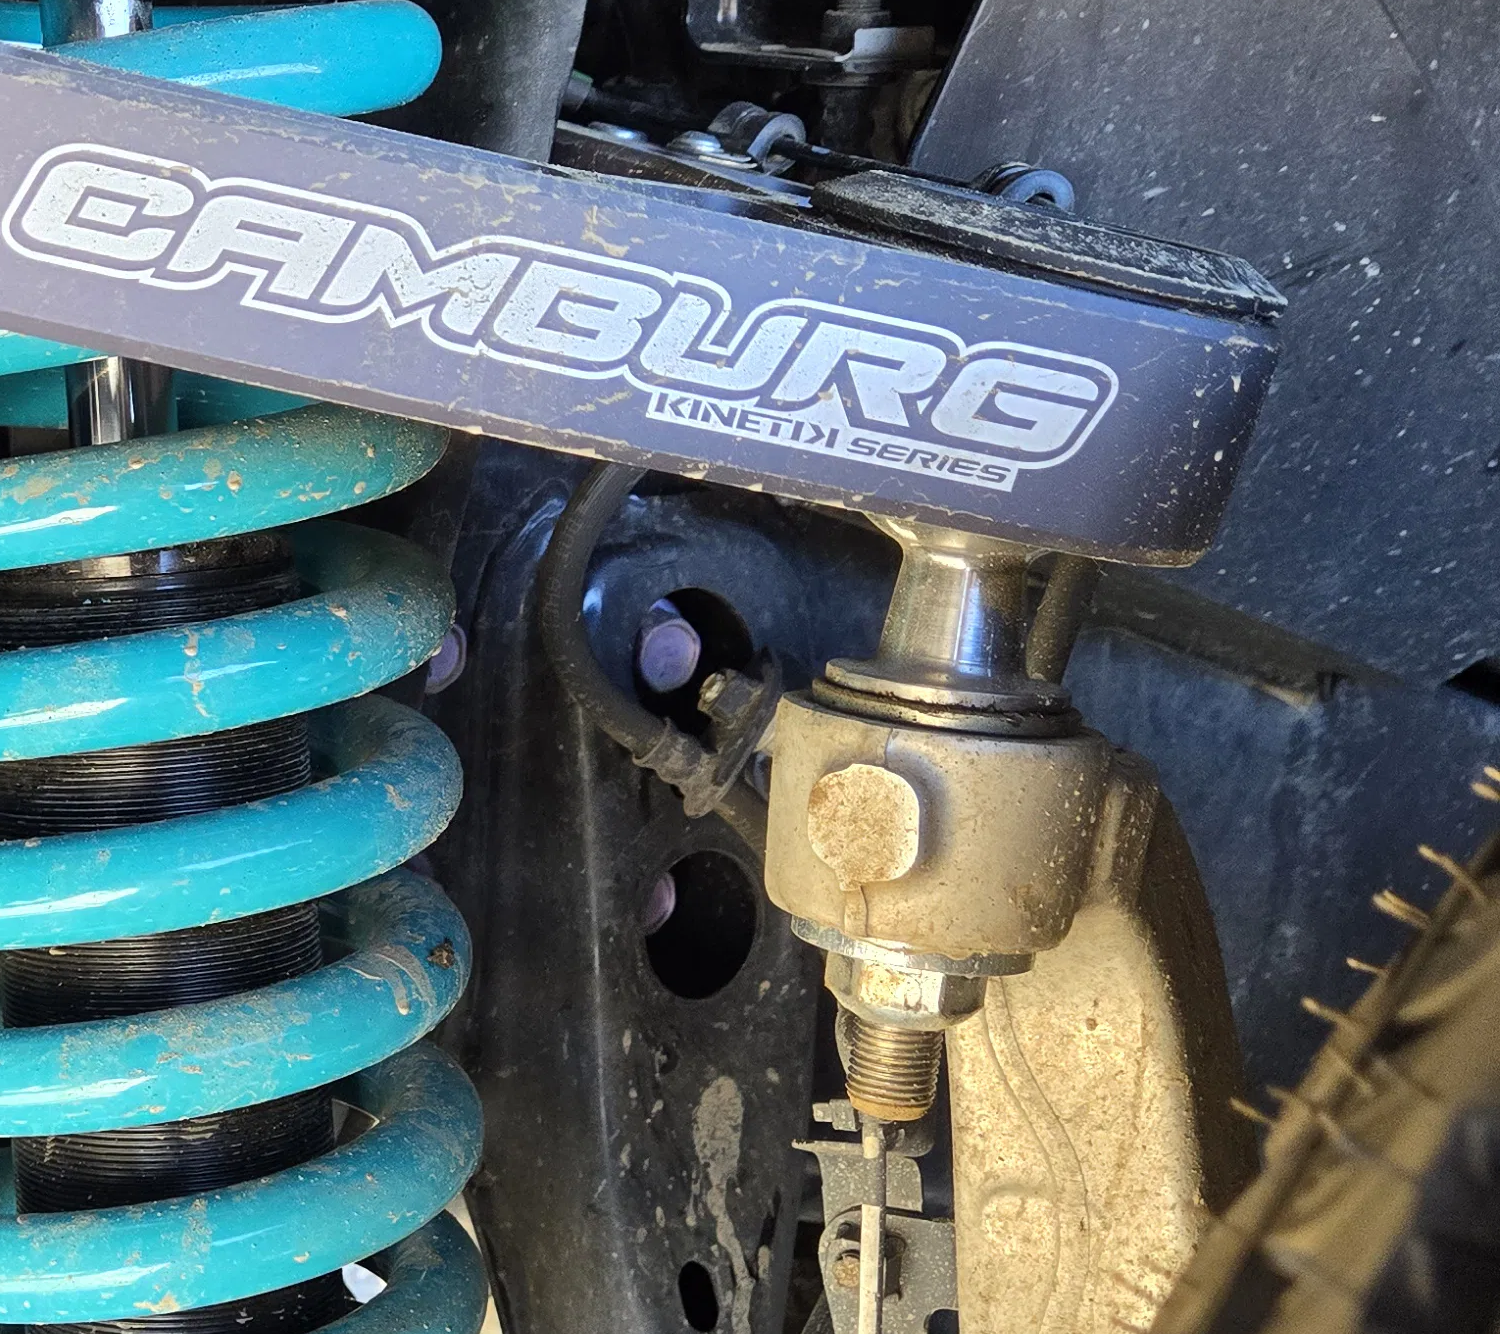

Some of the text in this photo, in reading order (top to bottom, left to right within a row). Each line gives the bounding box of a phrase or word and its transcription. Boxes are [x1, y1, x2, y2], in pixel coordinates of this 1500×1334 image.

[16, 155, 1105, 459] CAMBURG
[653, 392, 1013, 484] KINETIK SERIES
